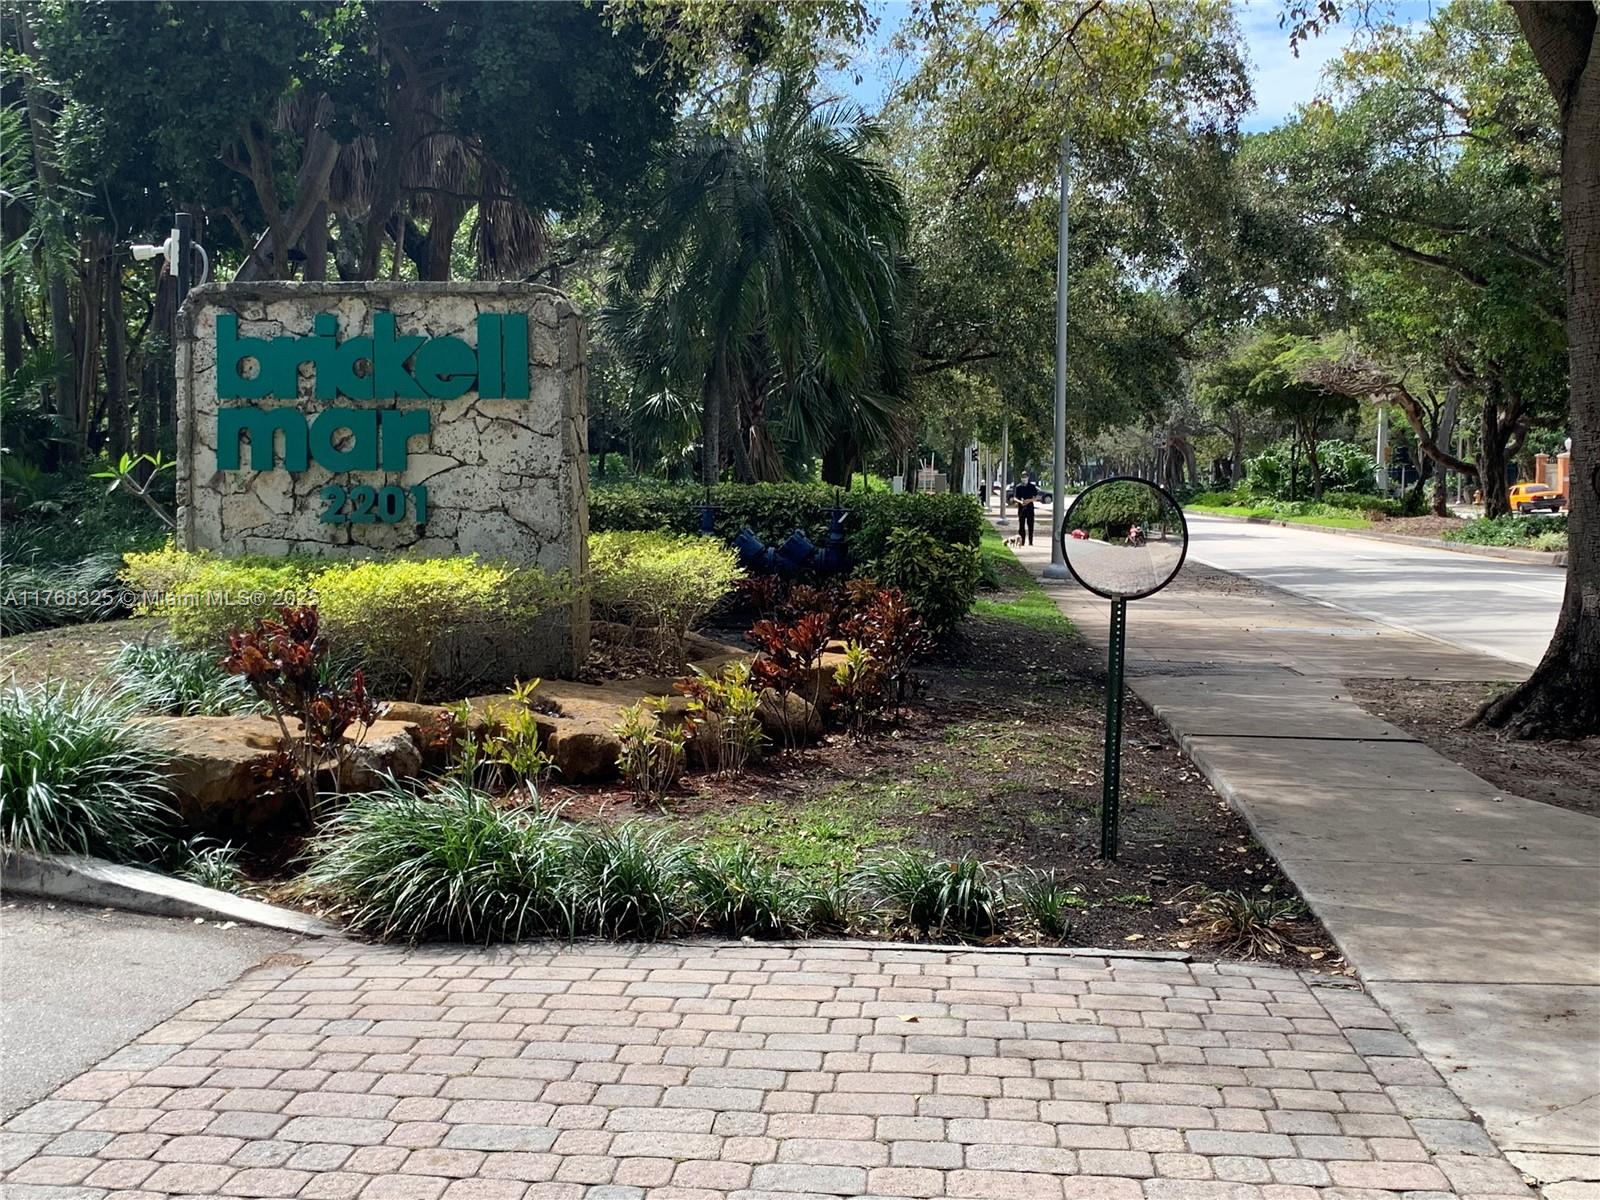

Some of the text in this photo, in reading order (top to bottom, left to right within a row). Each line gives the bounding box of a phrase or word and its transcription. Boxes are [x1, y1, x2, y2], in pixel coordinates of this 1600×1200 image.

[216, 312, 529, 400] brickell
[217, 406, 430, 472] mar
[320, 485, 427, 525] 2201
